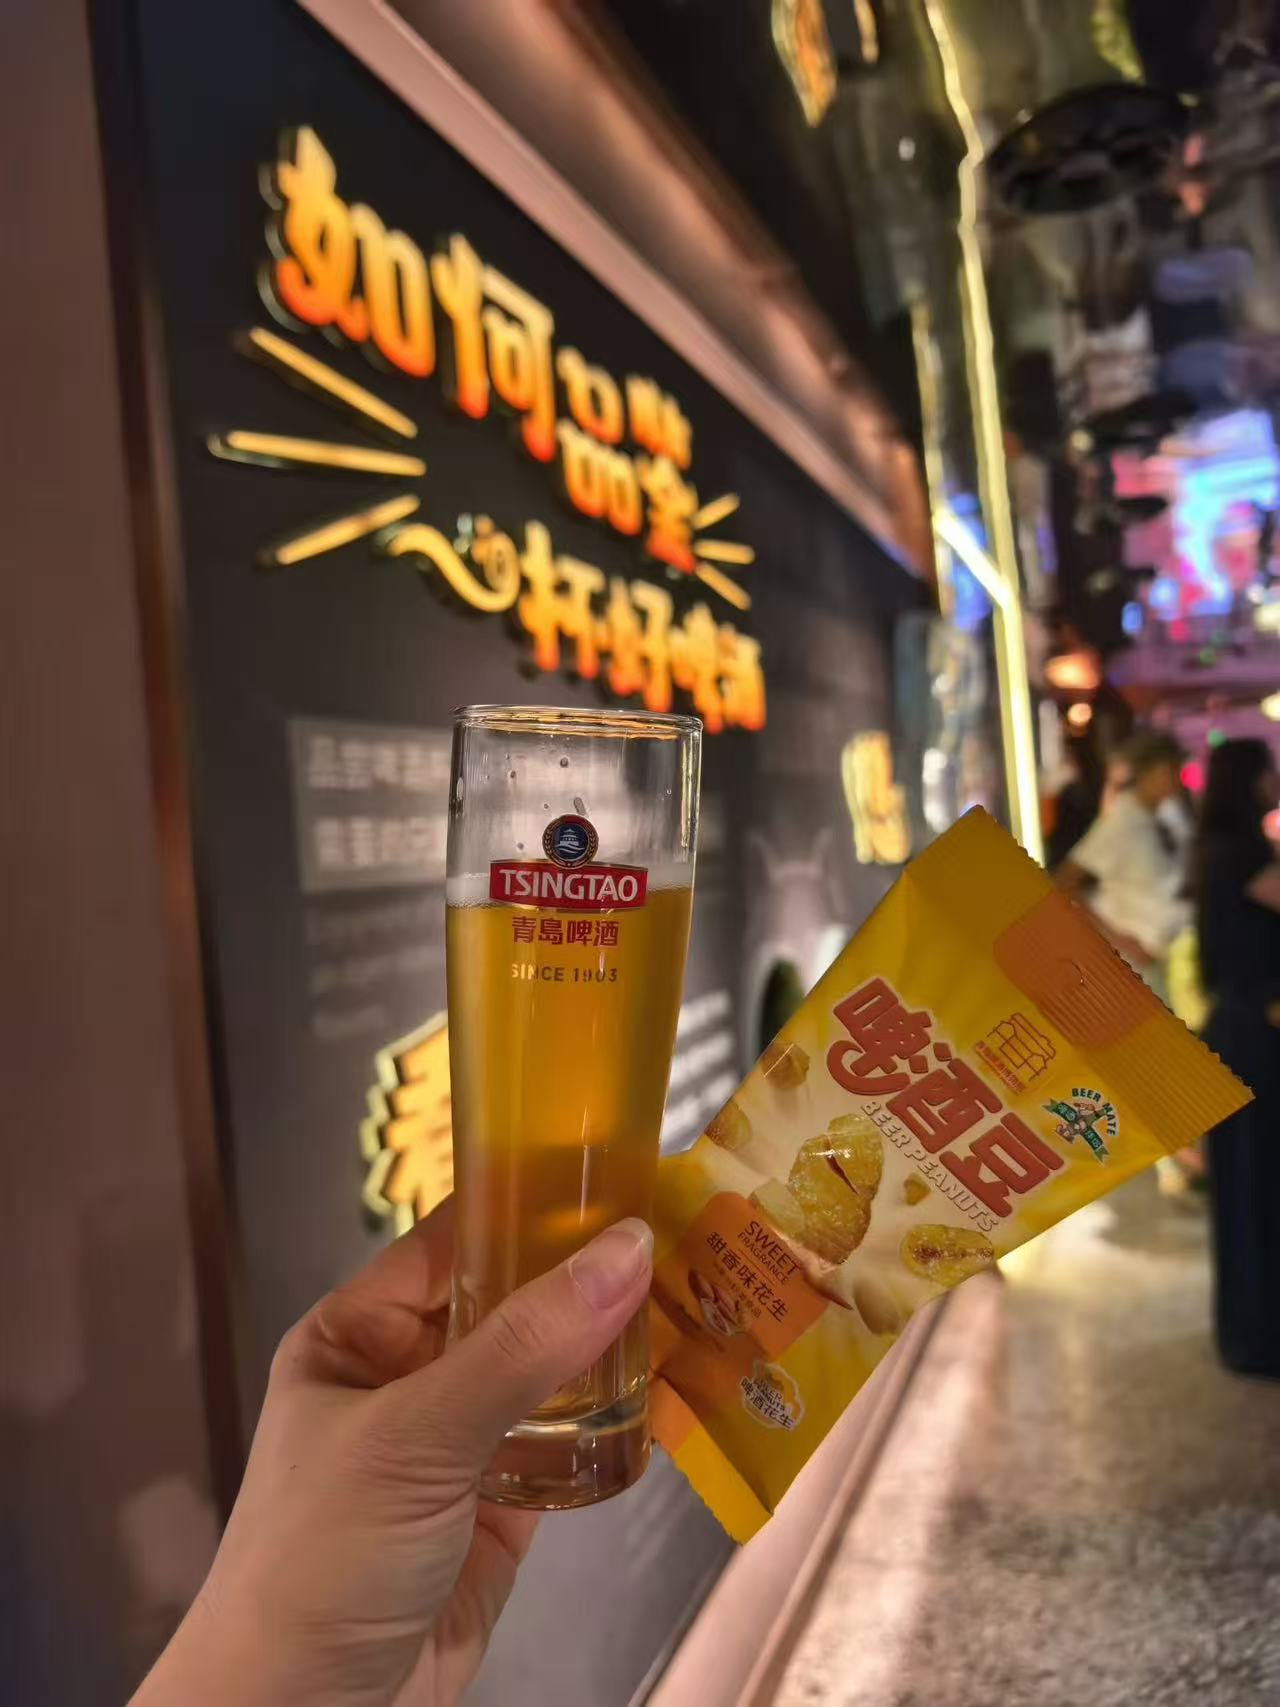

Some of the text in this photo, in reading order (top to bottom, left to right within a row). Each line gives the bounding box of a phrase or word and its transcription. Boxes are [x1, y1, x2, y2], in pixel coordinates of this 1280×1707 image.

[499, 869, 638, 902] TSINGTAO
[512, 916, 619, 947] 青島啤酒
[511, 963, 618, 983] SINCE 1903
[826, 977, 1065, 1218] 啤酒豆
[1072, 1088, 1117, 1136] BEER MATE
[861, 1100, 998, 1233] BEER PEANUTS
[738, 1232, 789, 1284] FRAGRANCE
[745, 1220, 800, 1276] SWEET
[706, 1231, 790, 1323] 甜香味花生
